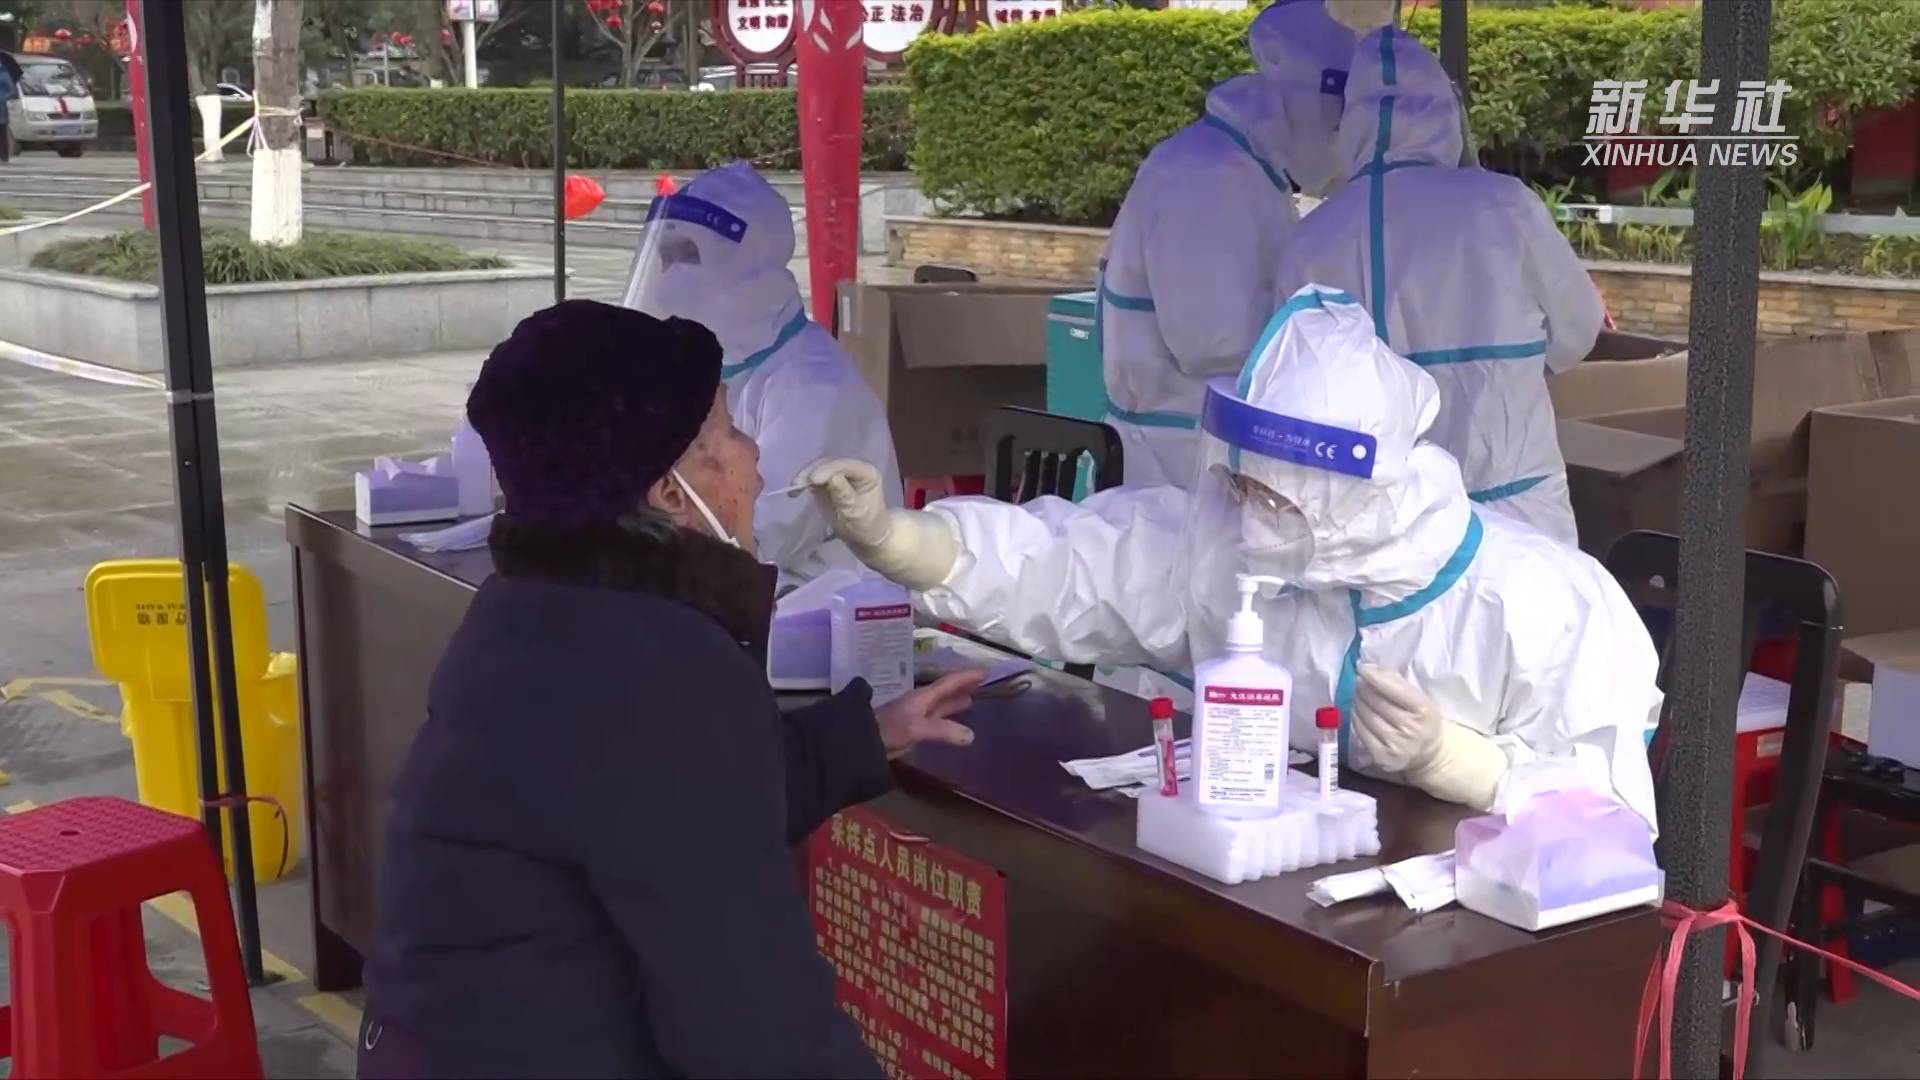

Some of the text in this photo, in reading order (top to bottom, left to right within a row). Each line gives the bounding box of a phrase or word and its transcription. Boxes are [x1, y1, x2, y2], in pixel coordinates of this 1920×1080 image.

[891, 4, 923, 21] 法治
[1315, 441, 1337, 460] CE
[831, 813, 982, 919] 采样点人员岗位职责
